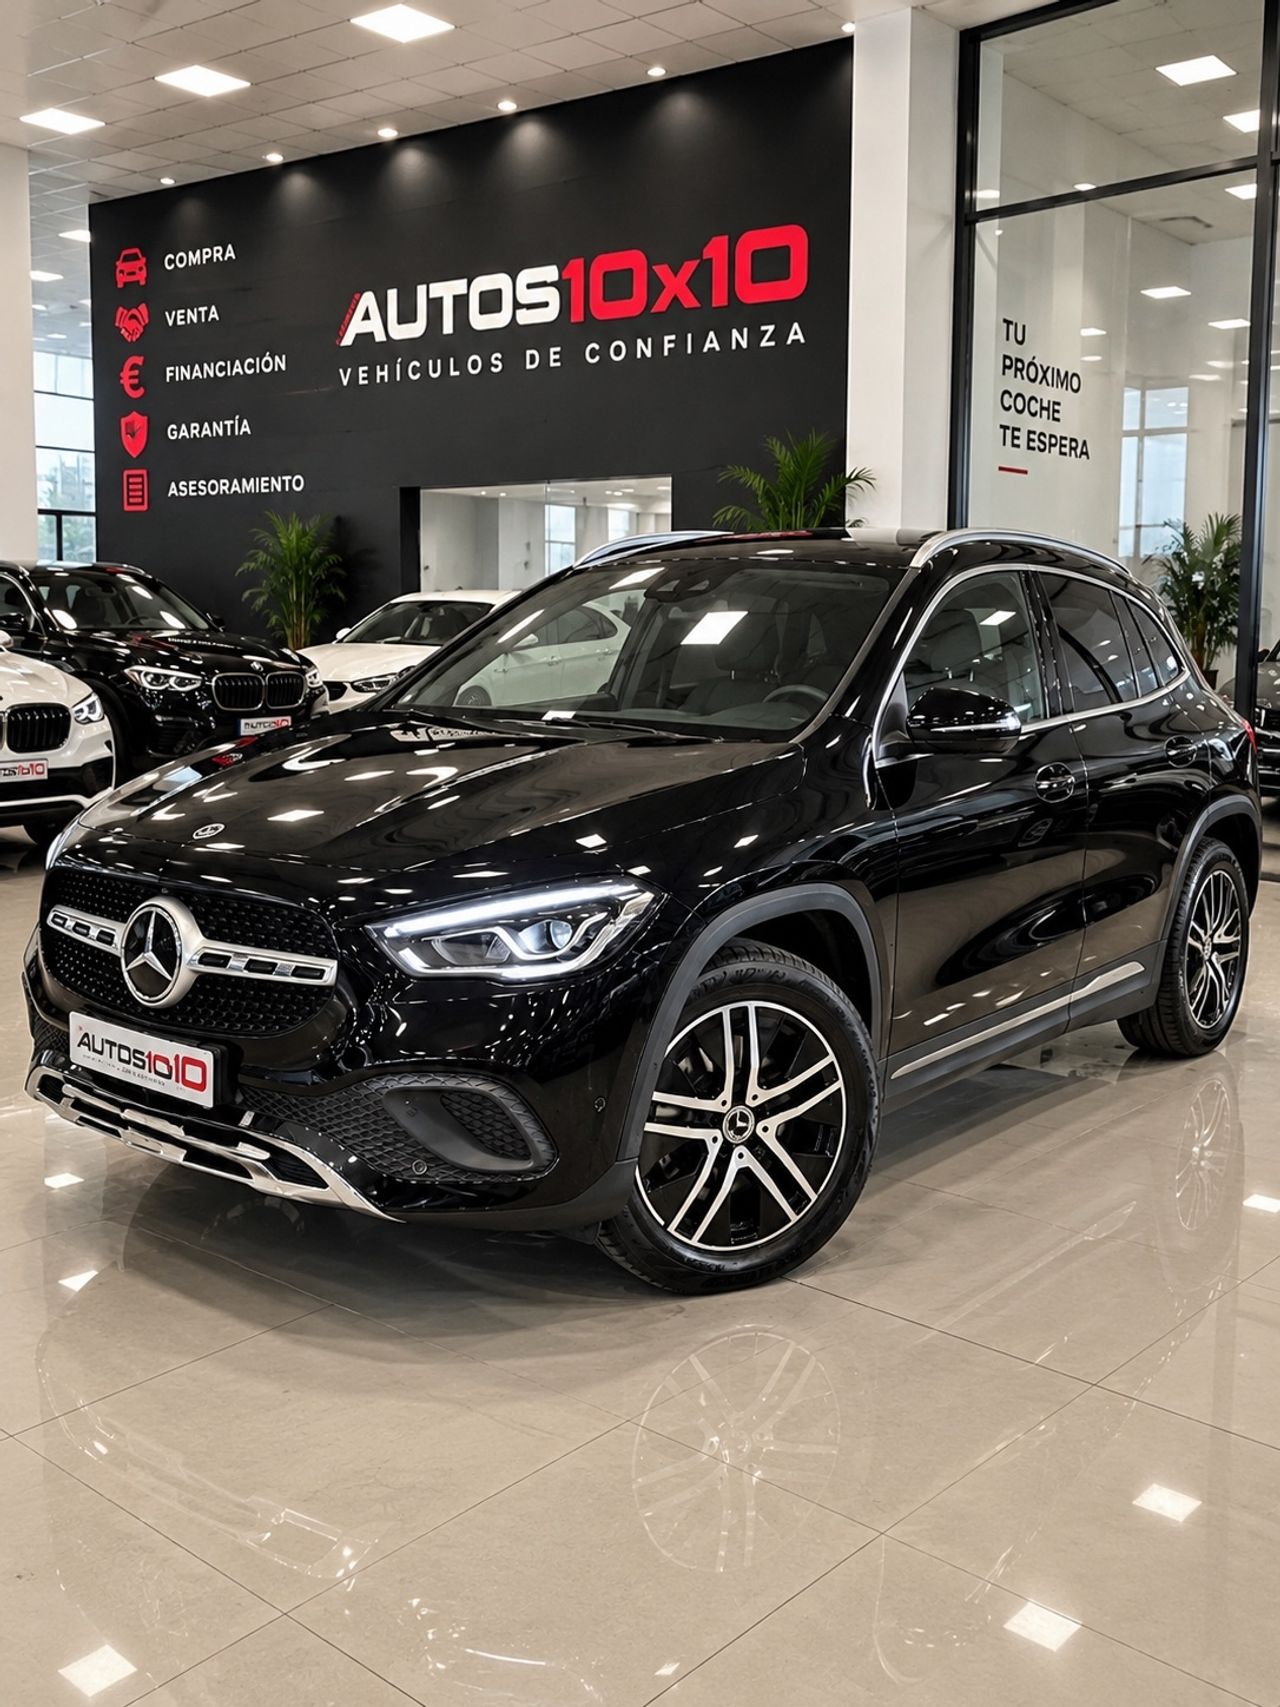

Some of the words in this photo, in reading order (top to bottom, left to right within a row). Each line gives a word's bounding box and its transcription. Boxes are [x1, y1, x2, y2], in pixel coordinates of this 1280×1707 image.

[164, 243, 236, 270] COMPRA
[165, 305, 220, 327] VENTA
[1003, 318, 1026, 346] TU
[165, 352, 287, 383] FINANCIACIÓN
[339, 354, 504, 387] VEHÍCULOS
[525, 346, 562, 370] DE
[585, 322, 806, 365] CONFIANZA
[1002, 354, 1082, 394] PRÓXIMO
[1000, 389, 1061, 423] COCHE
[167, 415, 251, 440] GARANTÍA
[999, 424, 1021, 449] TE
[1026, 429, 1090, 460] ESPERA
[168, 475, 305, 497] ASESORAMIENTO
